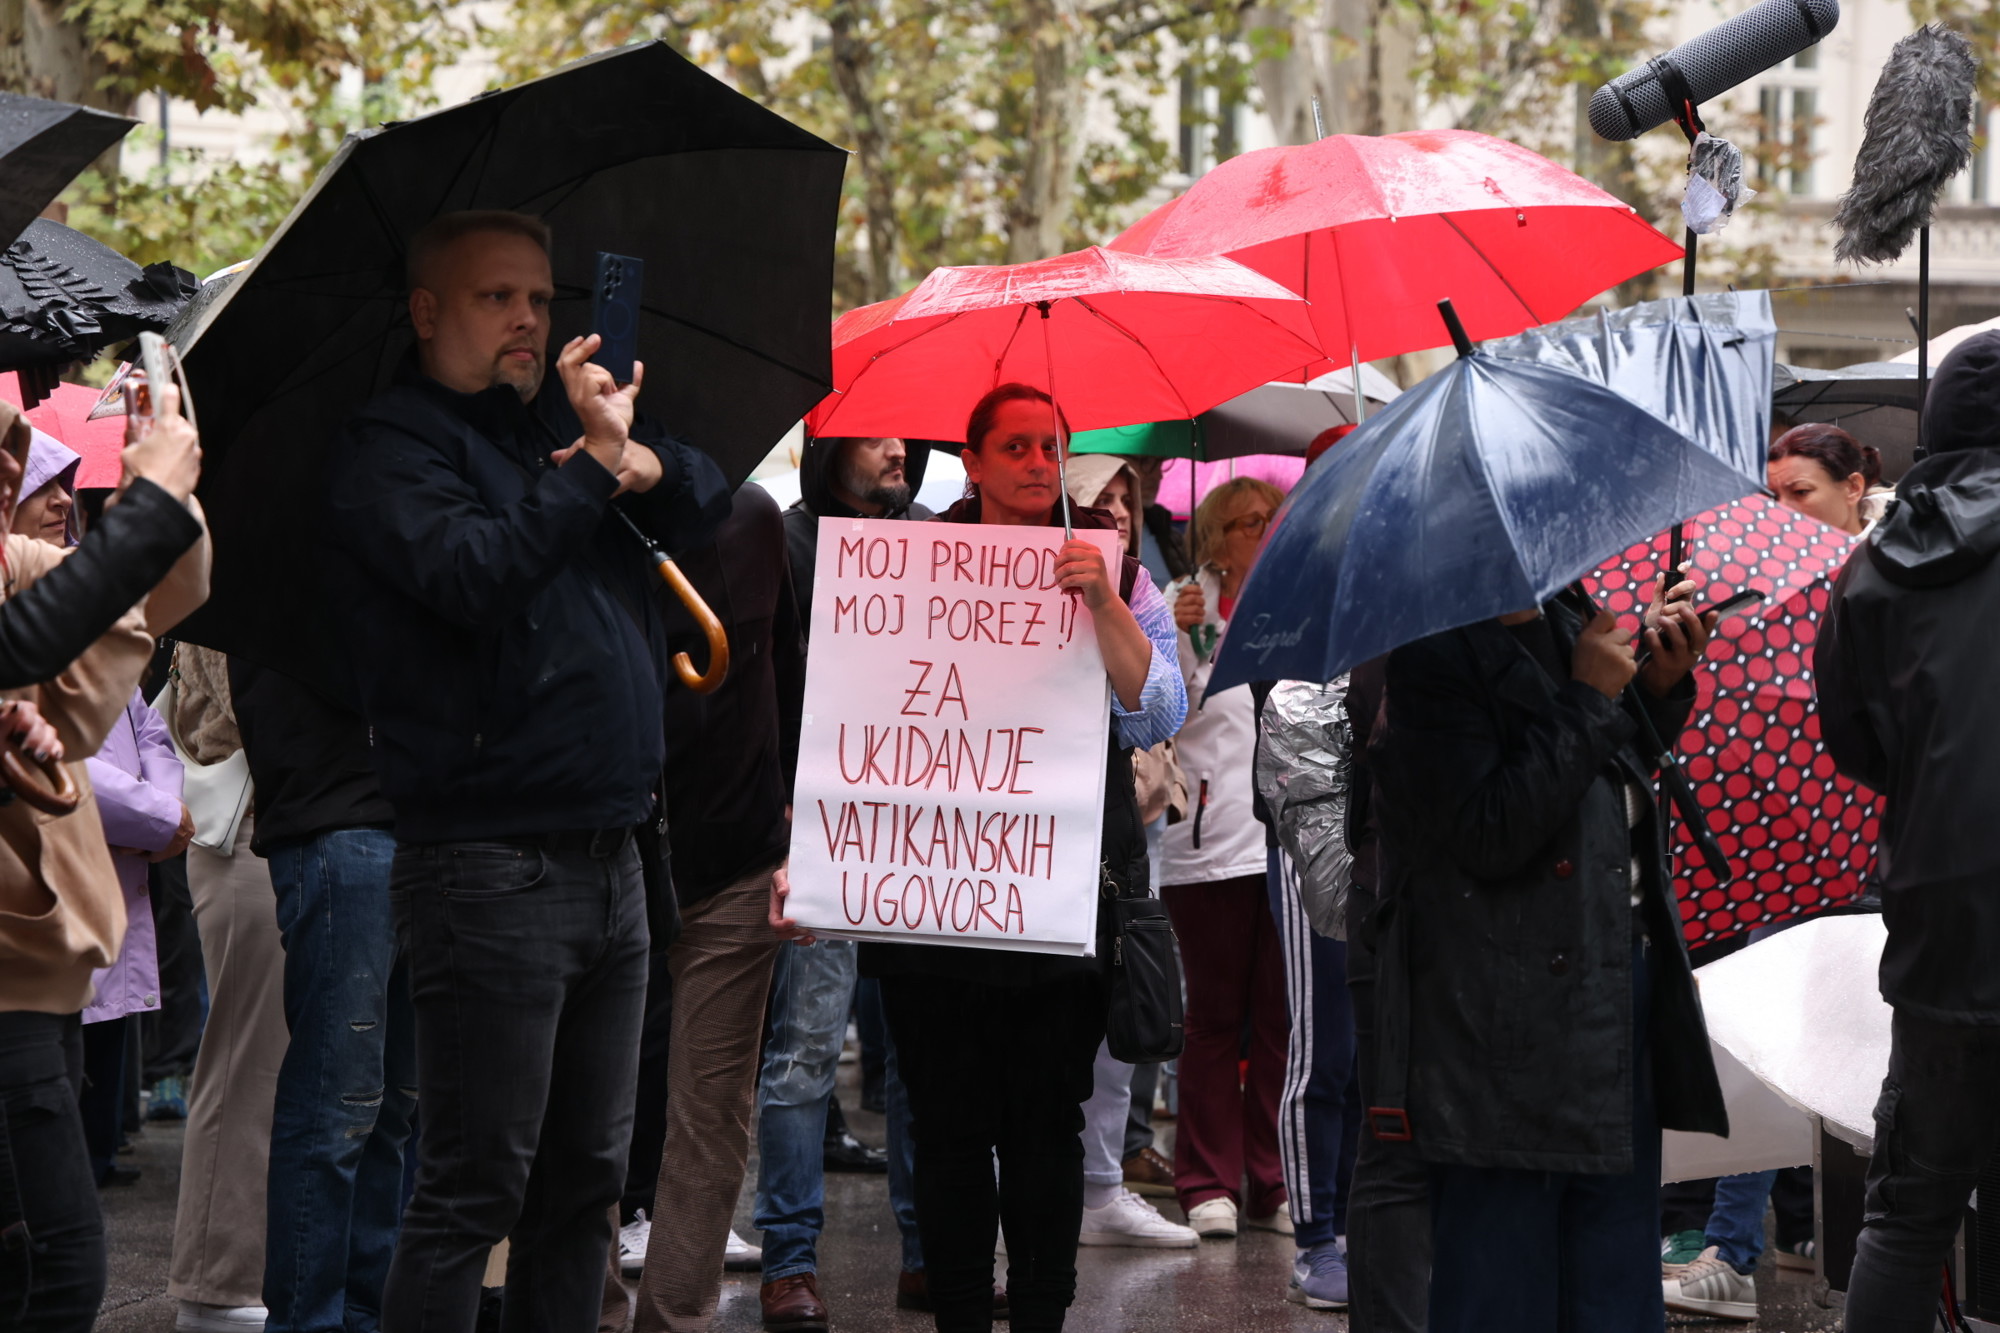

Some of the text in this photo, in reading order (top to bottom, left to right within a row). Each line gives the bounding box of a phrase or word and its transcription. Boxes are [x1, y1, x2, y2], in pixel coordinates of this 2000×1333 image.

[838, 536, 908, 580] MOJ
[834, 593, 904, 635] MOJ
[1242, 613, 1311, 664] Zagreb
[901, 659, 968, 720] ZA
[838, 722, 1045, 794] UKIDANJE
[817, 799, 1055, 879] VATIKANSKIH
[842, 871, 1024, 933] UGOVORA
